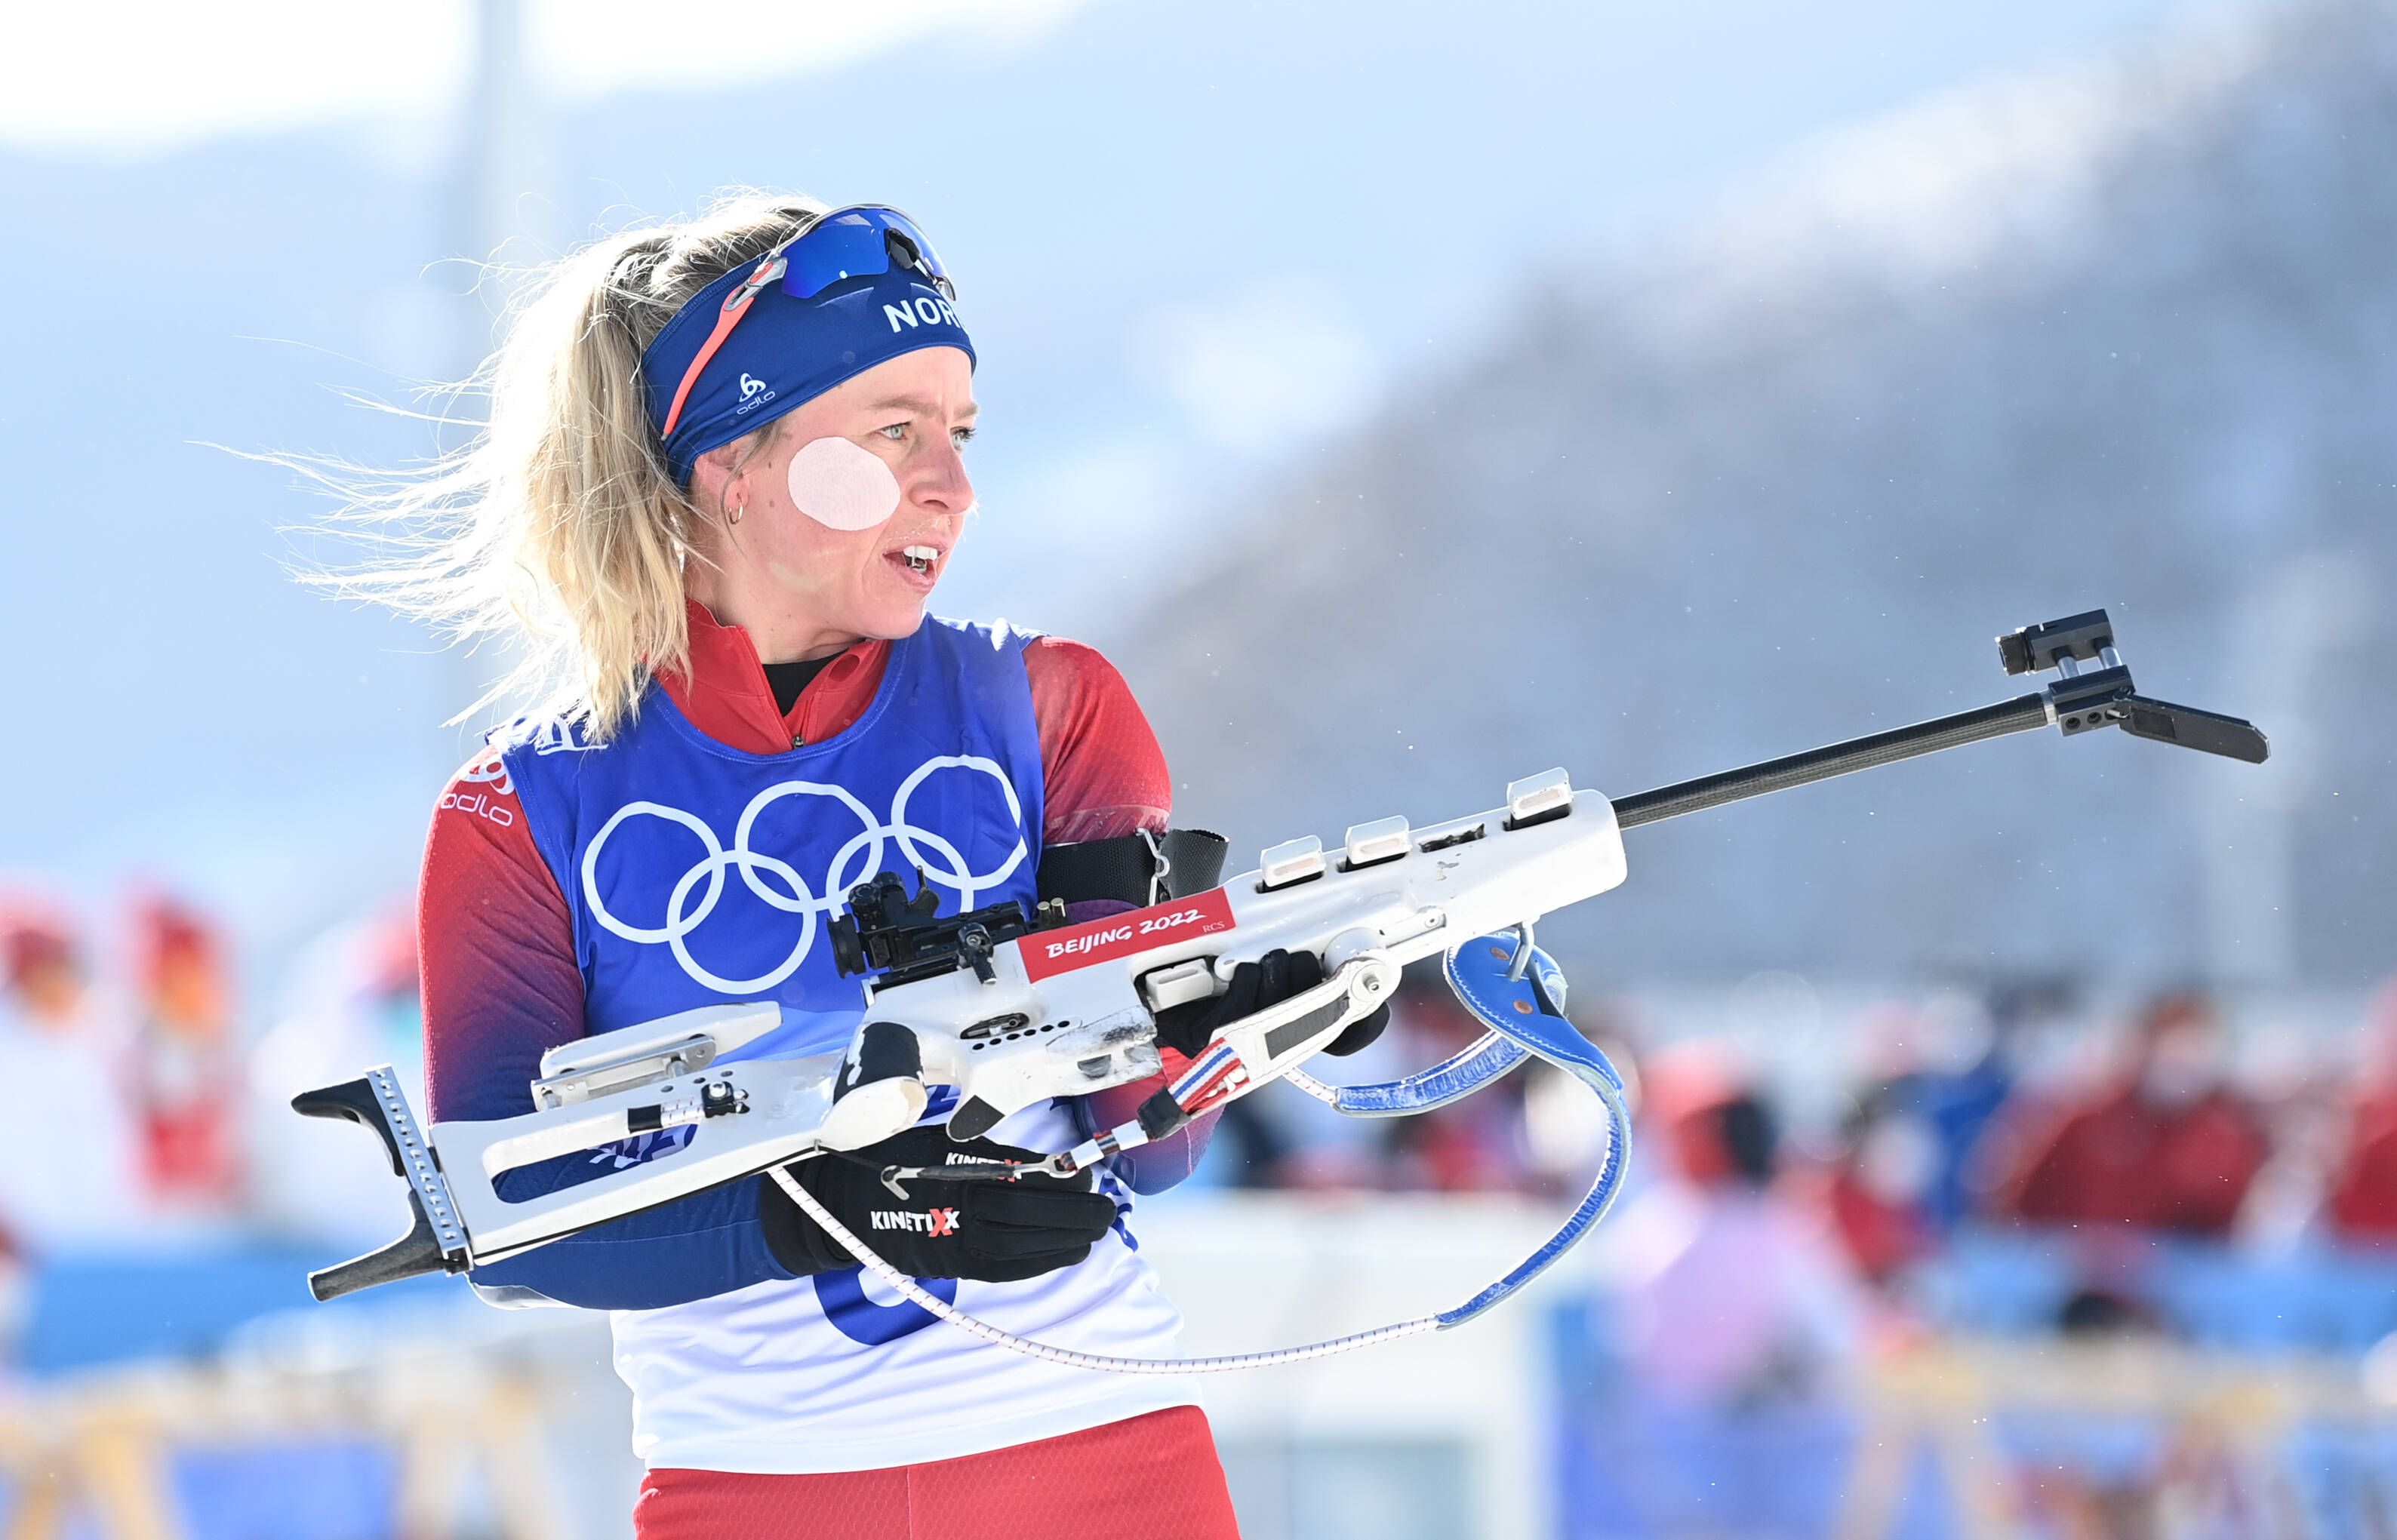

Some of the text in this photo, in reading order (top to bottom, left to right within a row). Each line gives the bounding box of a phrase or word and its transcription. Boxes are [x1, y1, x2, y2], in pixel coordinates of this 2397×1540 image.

[737, 391, 776, 415] odlo
[440, 793, 513, 827] odlo
[1045, 908, 1207, 959] BEIJING 2022
[1202, 921, 1226, 933] RCS
[870, 1207, 960, 1237] KINETIXX
